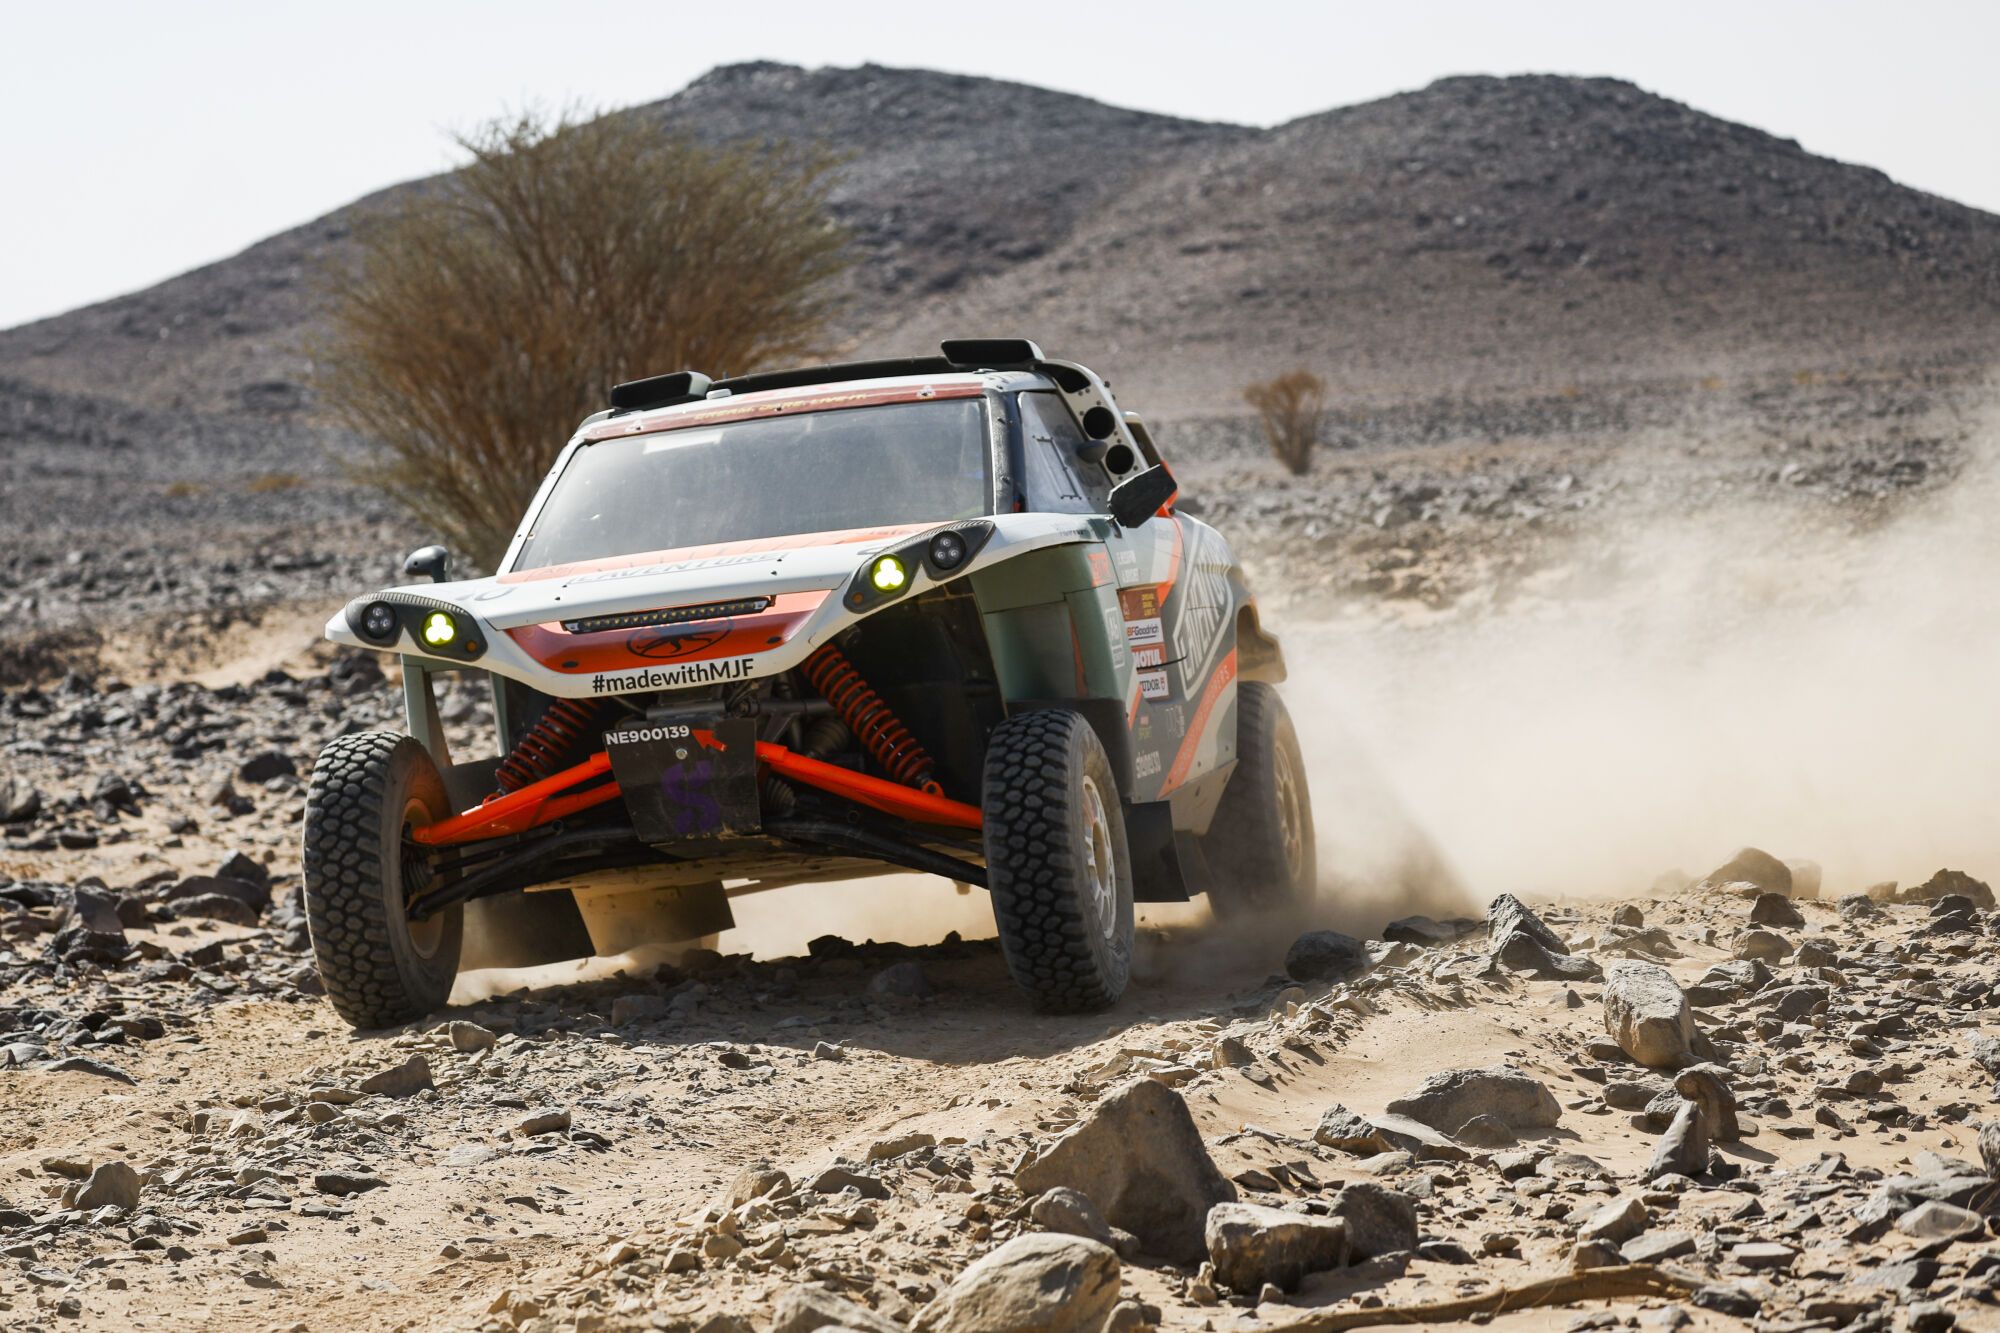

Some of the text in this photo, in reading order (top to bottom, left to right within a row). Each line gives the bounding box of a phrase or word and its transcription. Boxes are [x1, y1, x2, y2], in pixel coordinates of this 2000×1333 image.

[1126, 624, 1159, 636] BFGoodrich
[1132, 648, 1162, 668] MOTUL
[592, 658, 754, 693] #madewithMJF
[605, 725, 690, 745] NE900139
